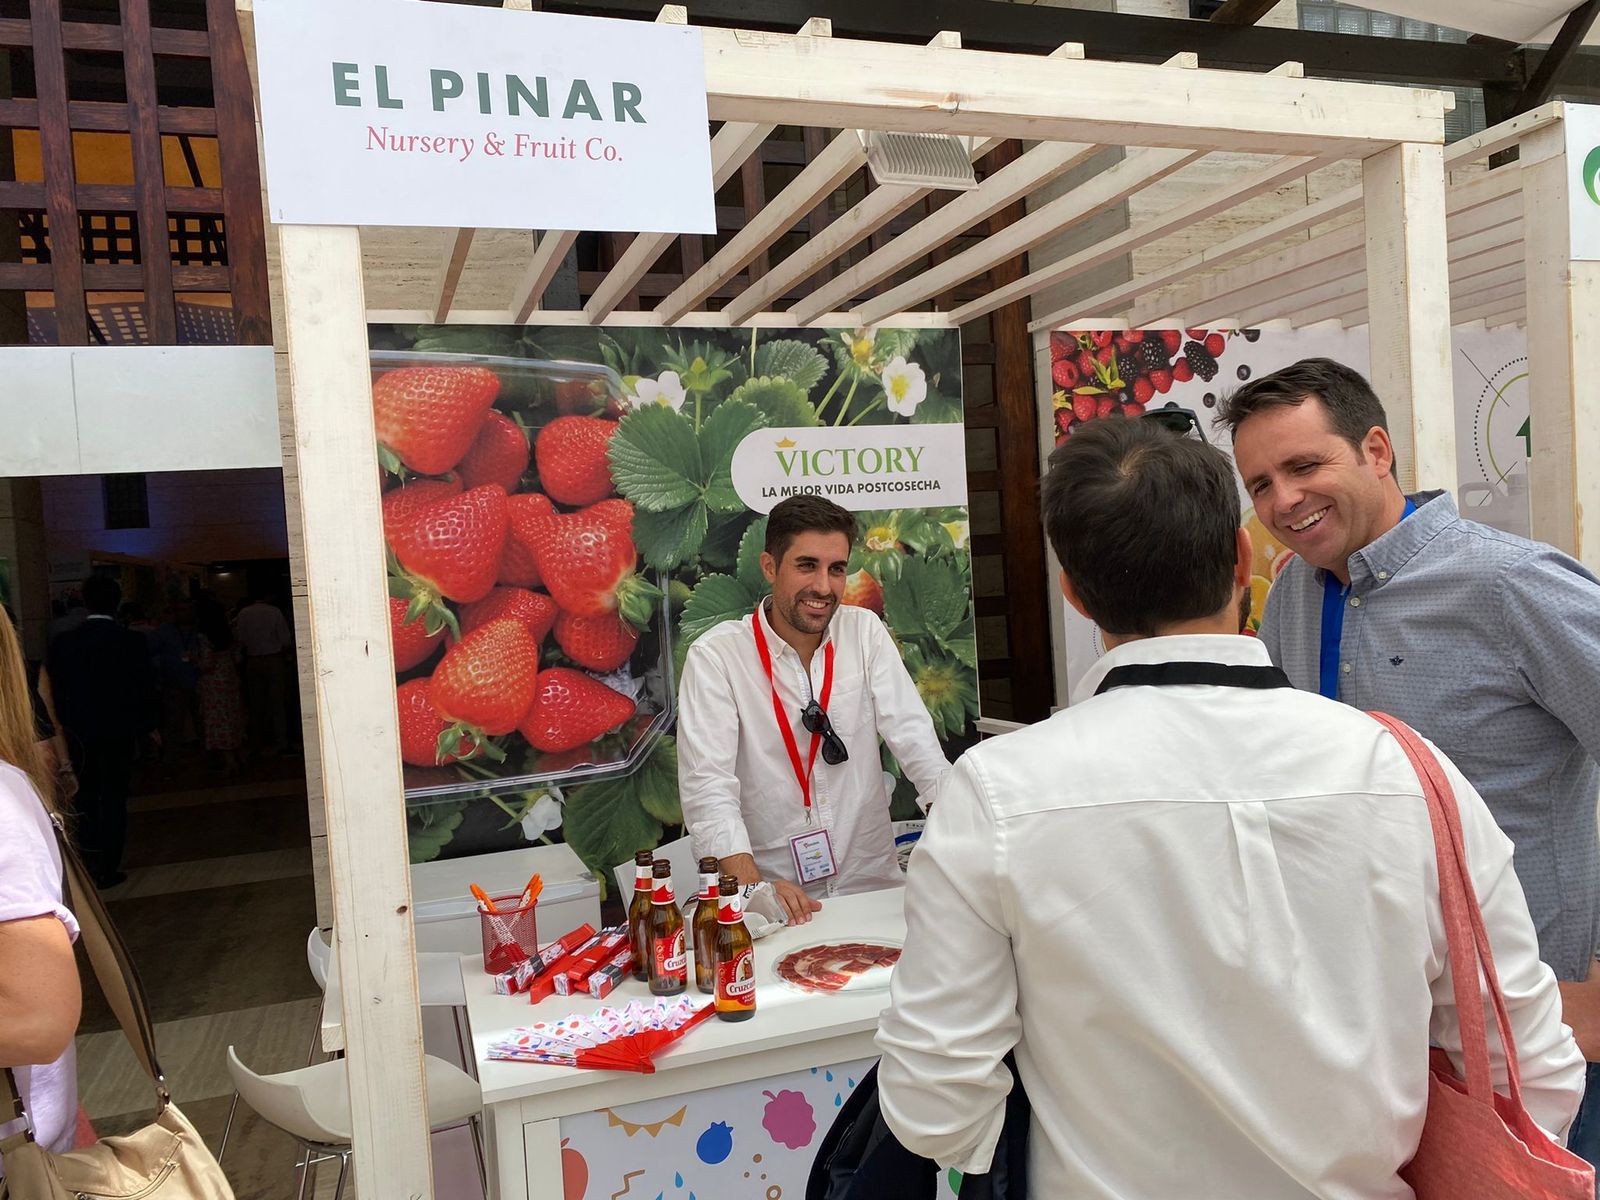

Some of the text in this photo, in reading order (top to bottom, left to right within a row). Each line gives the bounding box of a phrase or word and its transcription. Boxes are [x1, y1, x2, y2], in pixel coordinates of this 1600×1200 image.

[332, 62, 648, 124] EL PINAR
[366, 126, 622, 162] Nursery & Fruit Co.
[774, 447, 925, 478] VICTORY
[762, 480, 941, 497] LA MEJOR VIDA POSTCOSECHA
